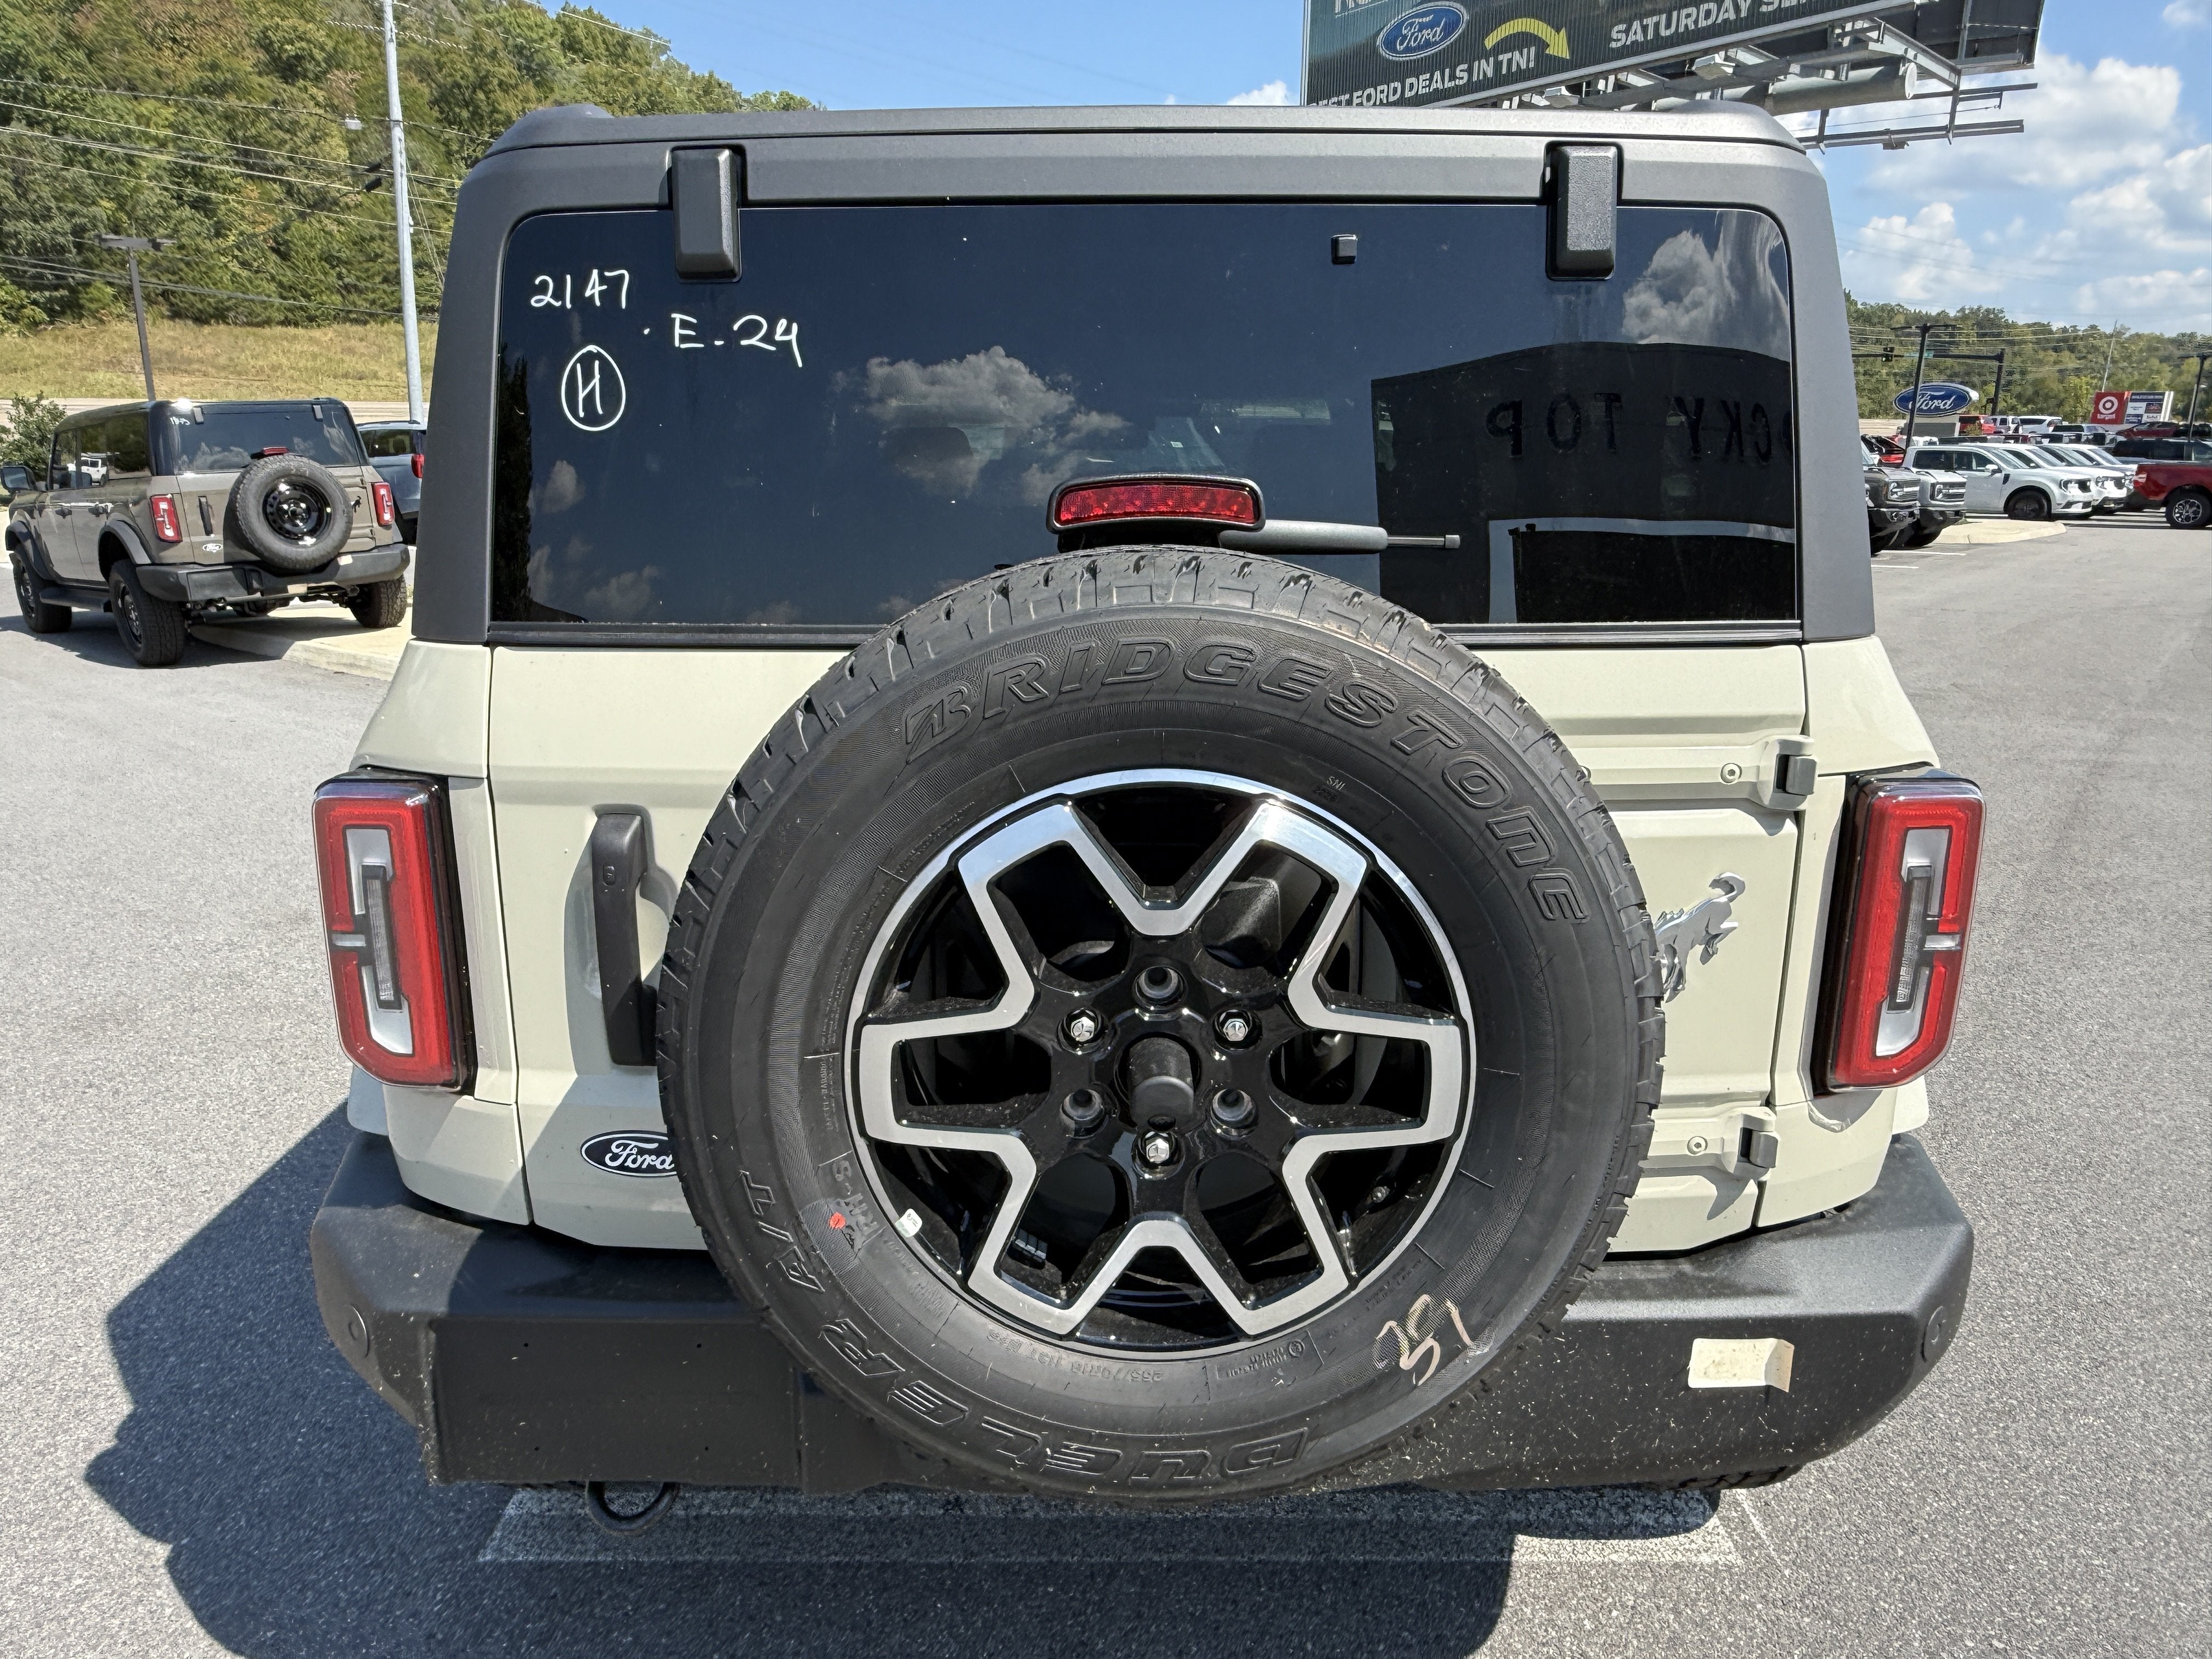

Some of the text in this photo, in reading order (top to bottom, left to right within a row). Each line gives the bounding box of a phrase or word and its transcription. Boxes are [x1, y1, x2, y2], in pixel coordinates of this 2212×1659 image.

[1397, 14, 1446, 51] Ford
[1609, 0, 1752, 48] SATURDAY
[1352, 81, 1402, 107] FORD
[1404, 63, 1469, 98] DEALS
[1472, 56, 1494, 82] IN
[1498, 46, 1536, 75] TN!
[530, 268, 630, 309] 2147
[1908, 391, 1957, 410] Ford
[903, 634, 1591, 924] BRIDGESTONE
[605, 1139, 675, 1170] Ford
[738, 1169, 1310, 1480] DUELER A/T
